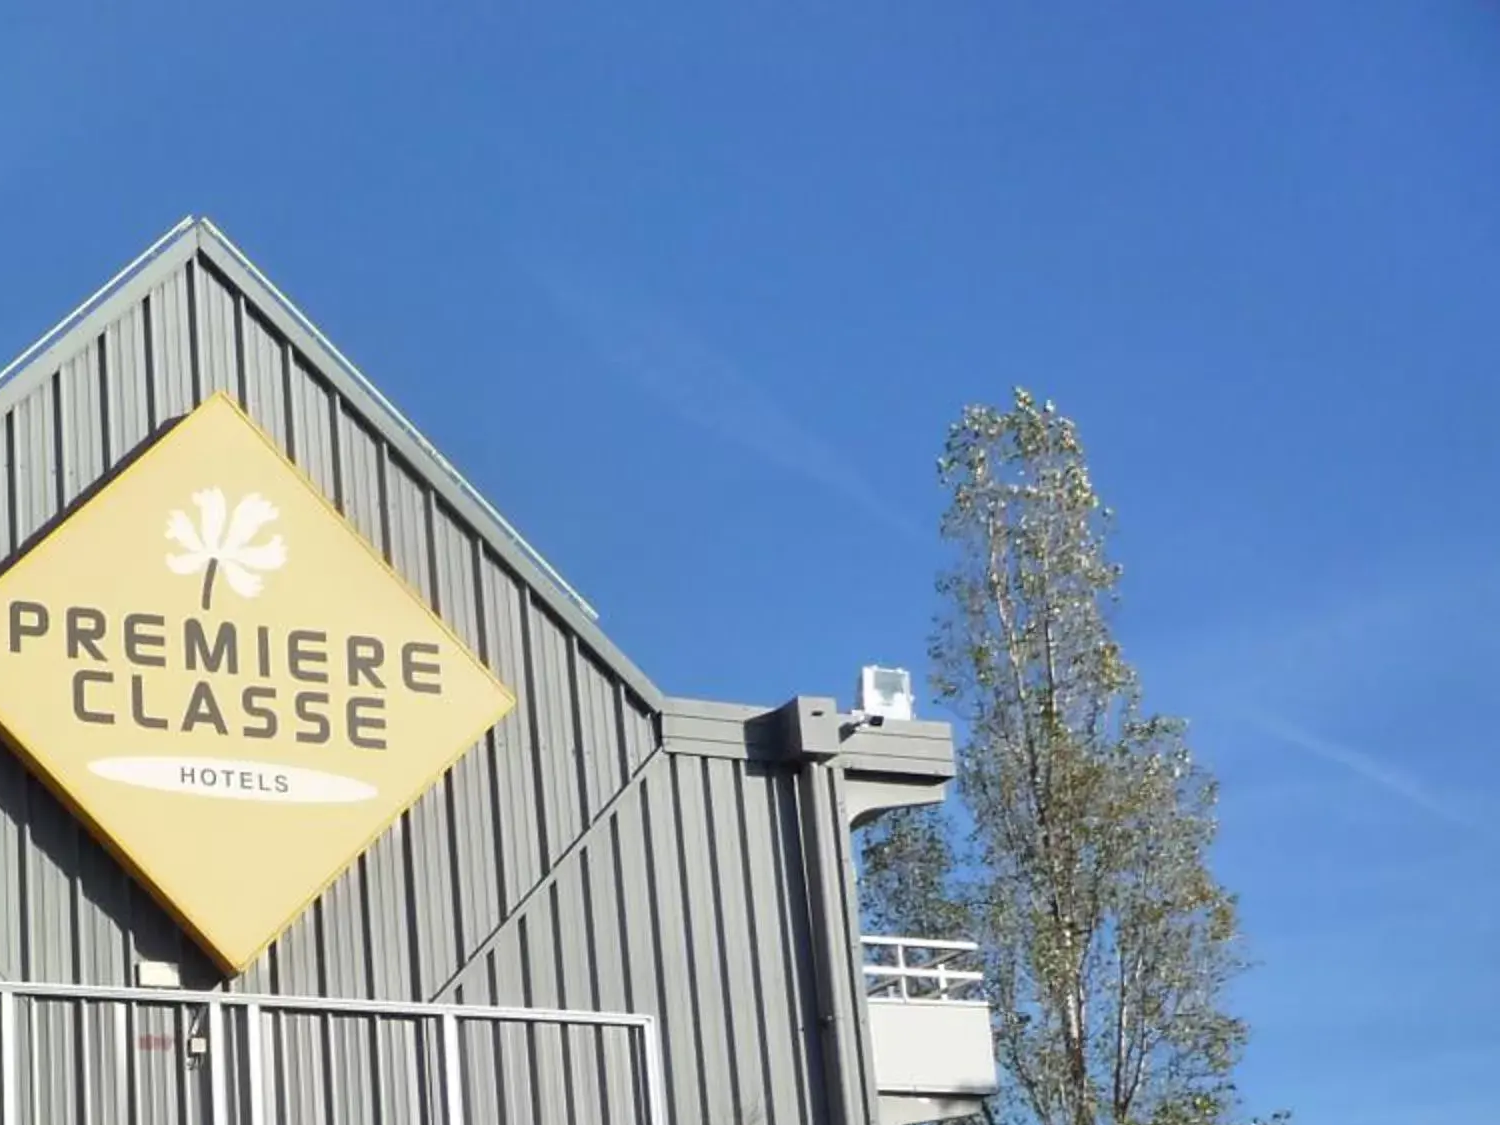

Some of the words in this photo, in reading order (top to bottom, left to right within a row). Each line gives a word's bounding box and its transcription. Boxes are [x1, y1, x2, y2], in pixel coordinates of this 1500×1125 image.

[9, 600, 442, 694] PREMIERE
[72, 669, 387, 750] CLASSE
[180, 766, 289, 793] HOTELS
